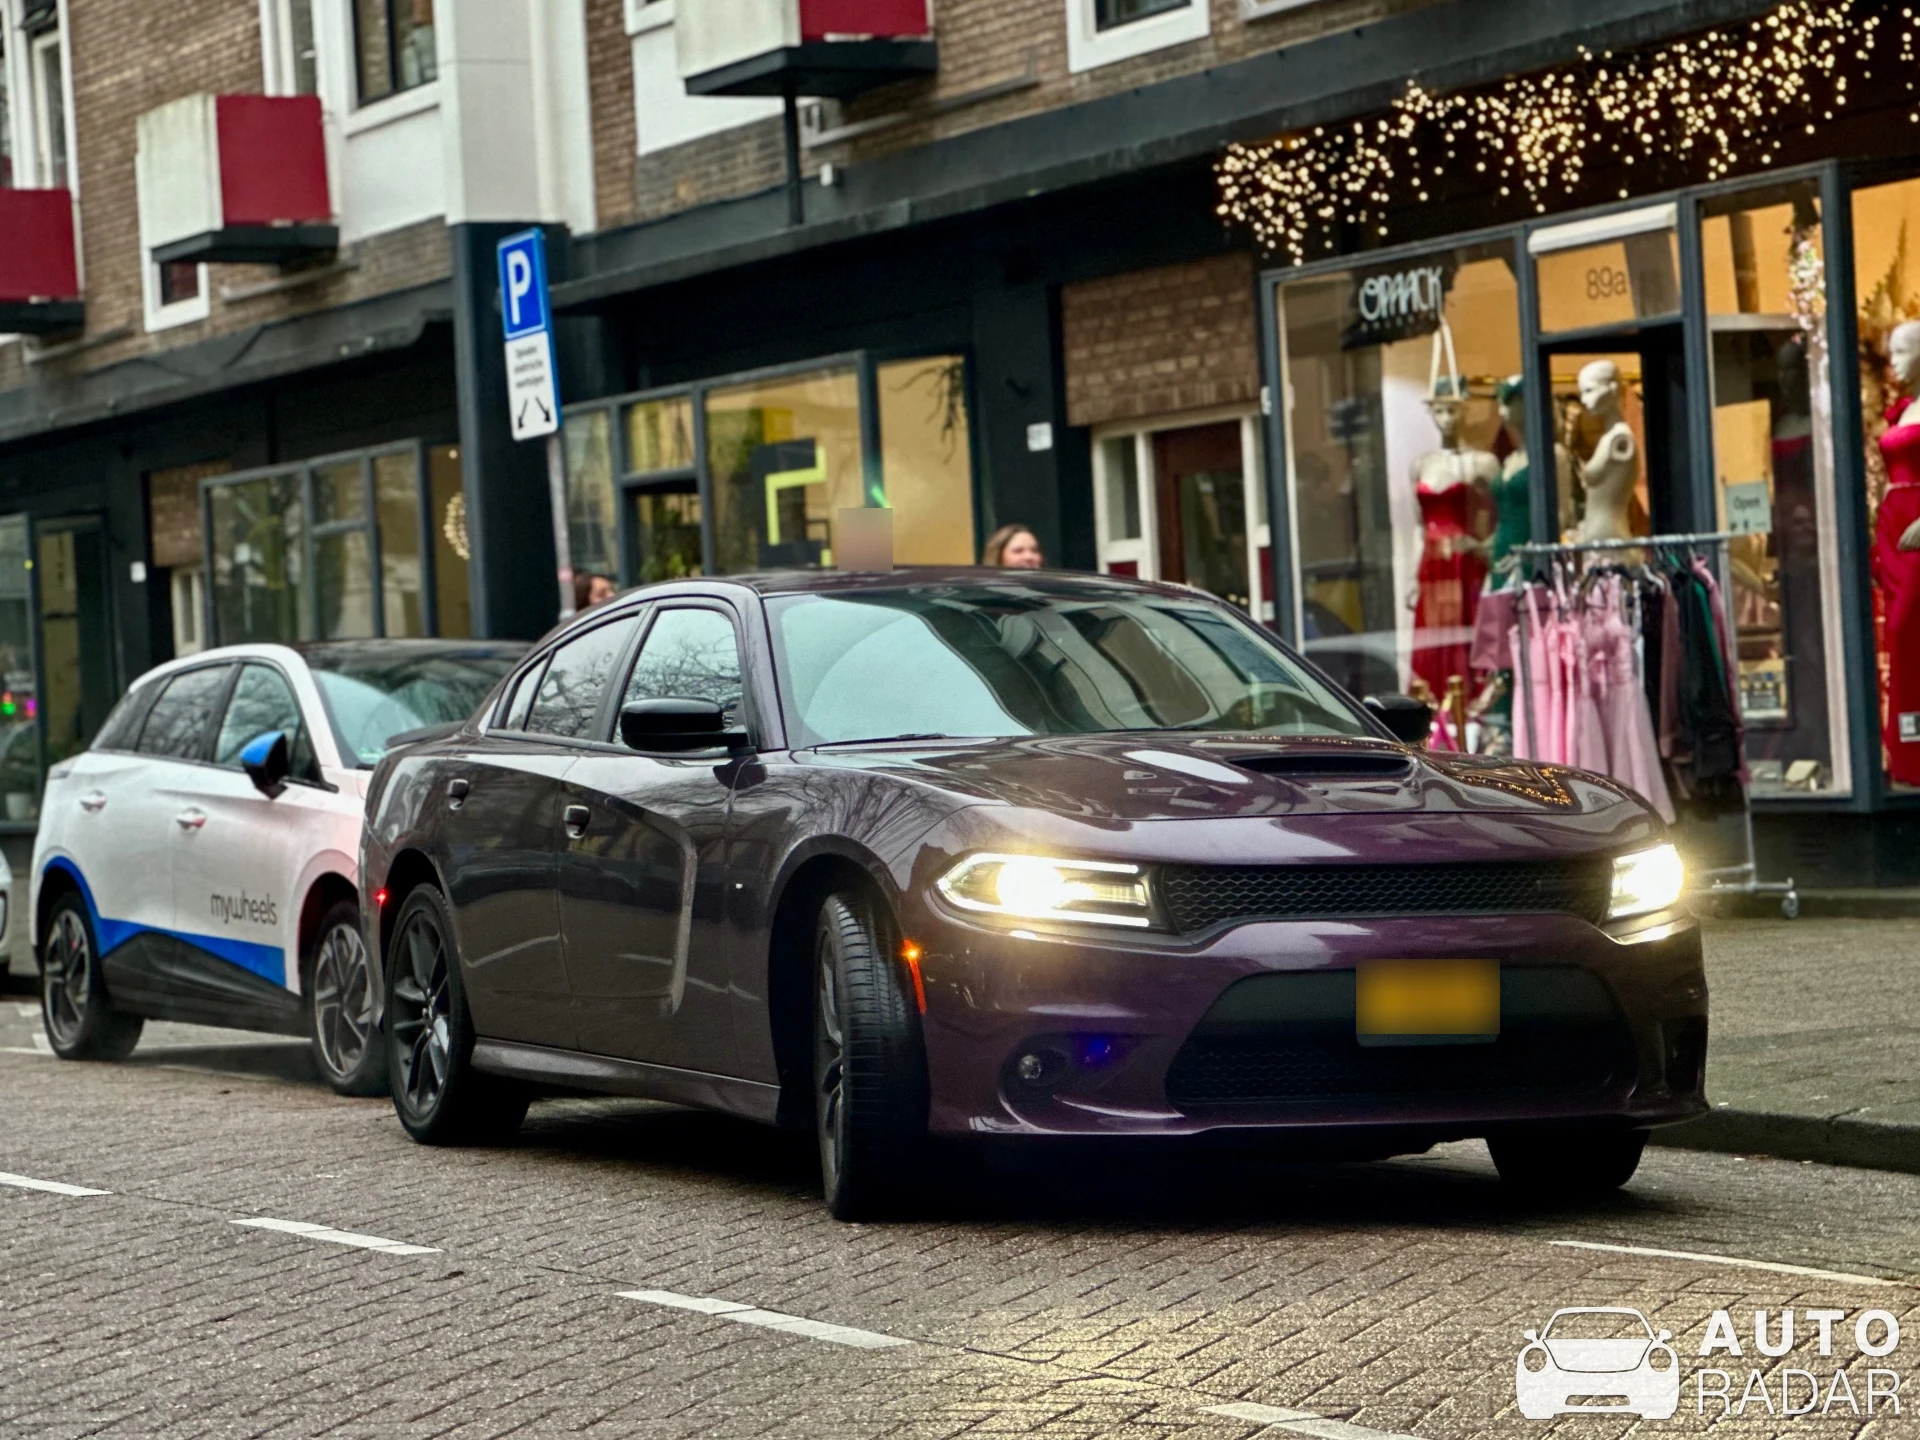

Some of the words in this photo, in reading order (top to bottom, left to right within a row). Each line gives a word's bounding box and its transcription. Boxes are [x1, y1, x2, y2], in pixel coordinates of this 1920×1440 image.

[507, 249, 532, 325] P
[1586, 265, 1627, 300] 89a
[1733, 496, 1761, 512] Open
[210, 889, 278, 926] mywheels
